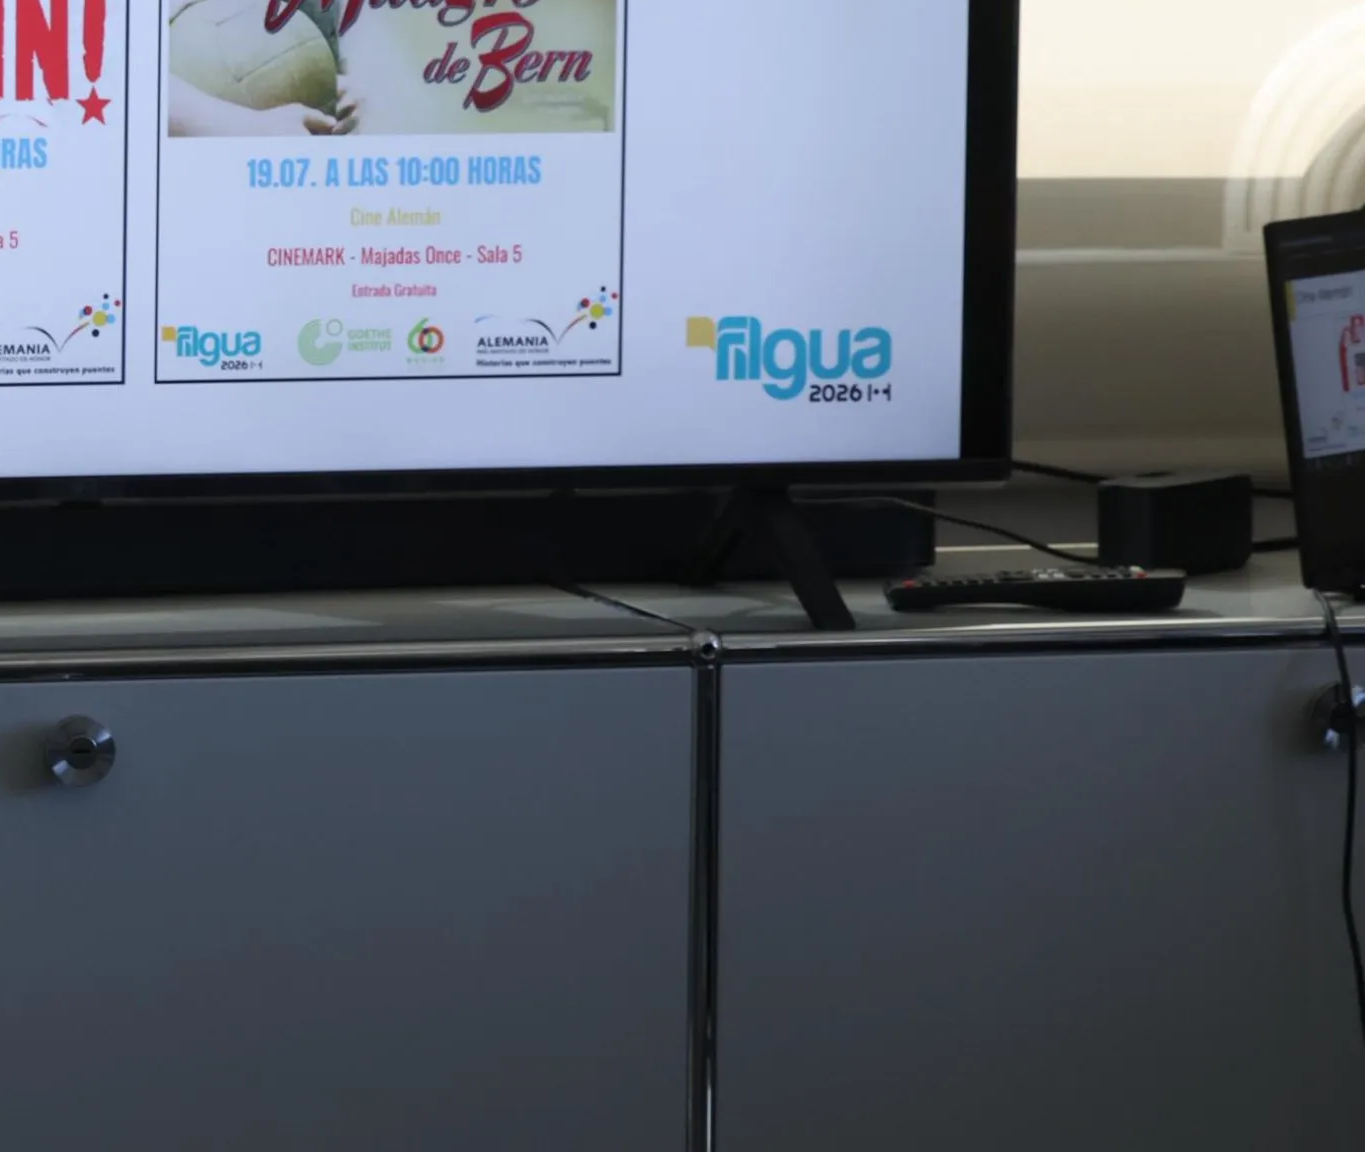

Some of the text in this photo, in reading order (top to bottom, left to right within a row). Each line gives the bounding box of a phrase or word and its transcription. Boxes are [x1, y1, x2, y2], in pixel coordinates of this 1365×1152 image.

[423, 12, 592, 112] de Bern
[247, 156, 541, 188] 19.07. A LAS 10:00 HORAS
[350, 209, 382, 227] Cine
[8, 231, 19, 249] 5
[267, 248, 345, 266] CINEMARK
[361, 247, 420, 267] Majadas
[425, 247, 462, 265] Once
[477, 245, 508, 264] Sala
[512, 245, 522, 263] 5
[352, 283, 436, 298] Entrada Gratuita
[477, 337, 549, 347] ALEMANIA
[809, 384, 862, 402] 2026
